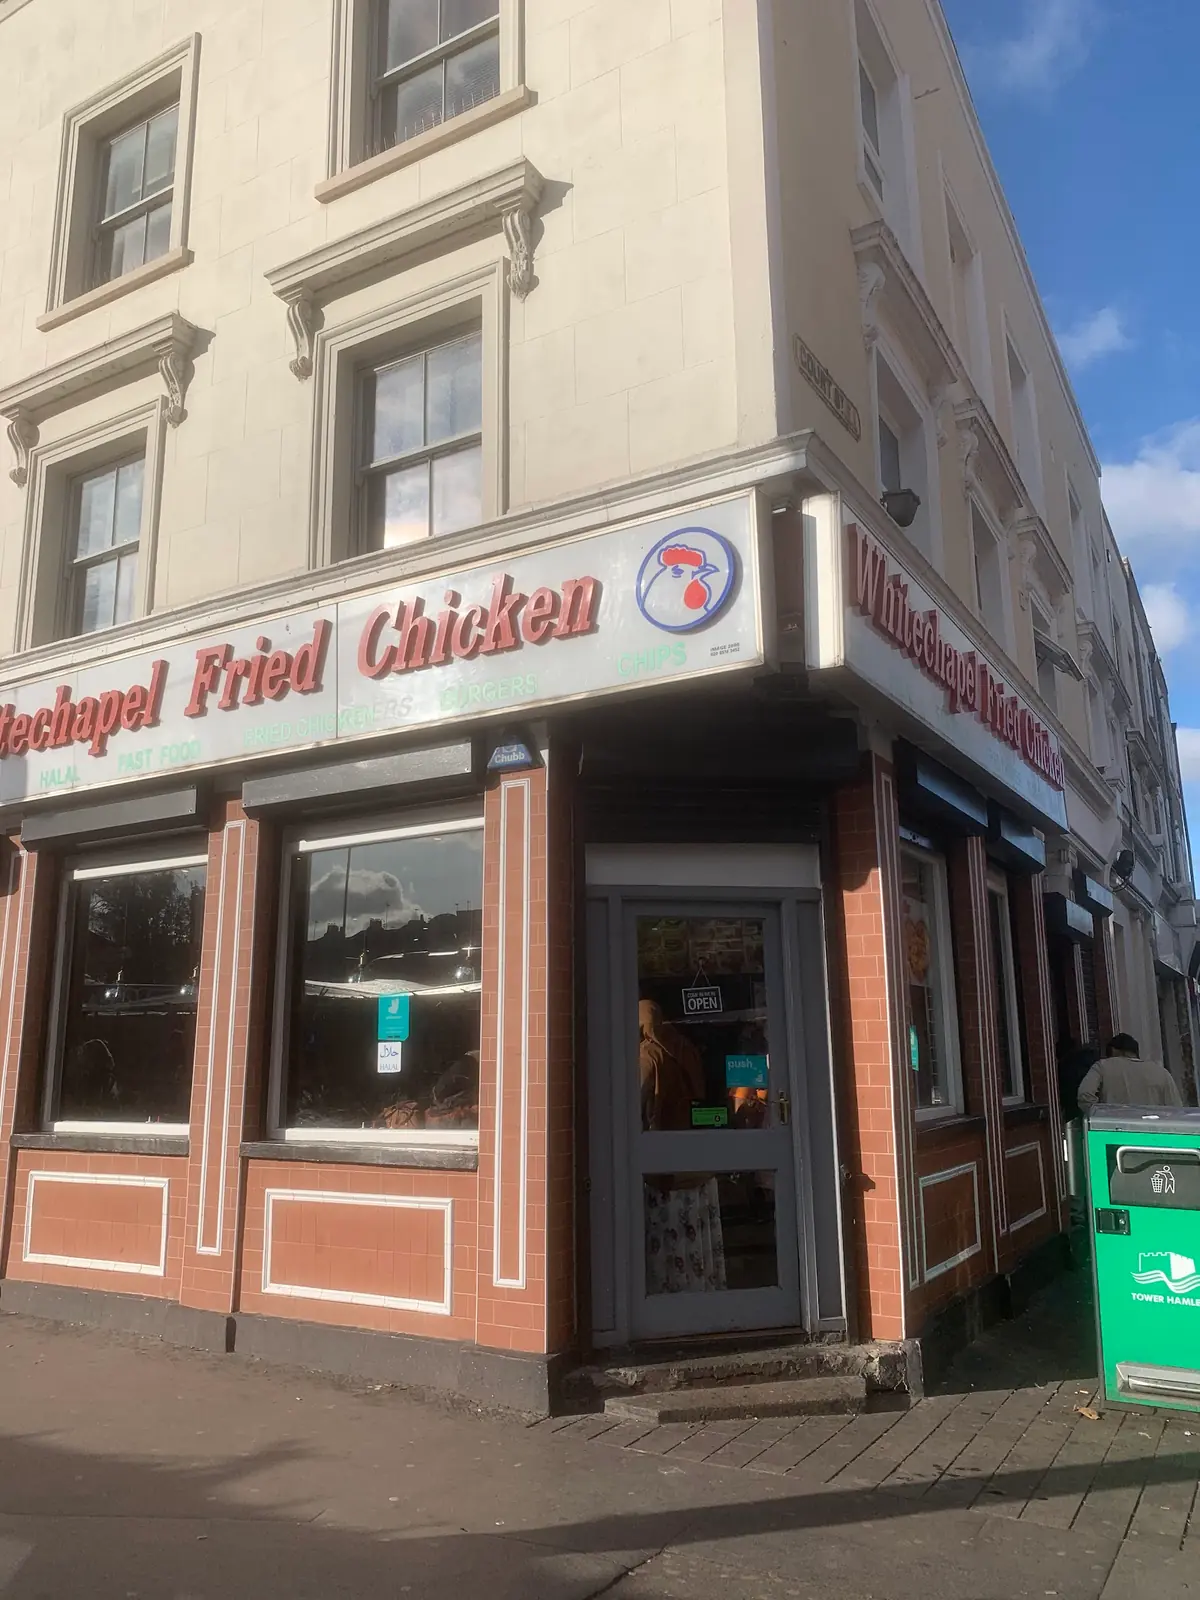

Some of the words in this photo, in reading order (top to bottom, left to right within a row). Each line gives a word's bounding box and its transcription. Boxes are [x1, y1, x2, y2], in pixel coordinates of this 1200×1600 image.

[184, 619, 333, 717] Fried
[357, 573, 602, 680] Chicken
[847, 523, 981, 714] Whitechapel
[980, 664, 1020, 750] Fried
[1019, 709, 1065, 791] Chicken
[40, 765, 81, 788] HALAL
[117, 749, 153, 773] FAST
[159, 739, 201, 766] FOOD
[244, 723, 292, 748] FRIED
[297, 706, 376, 738] CHICKEN
[439, 674, 538, 712] BURGERS
[617, 641, 687, 677] CHIPS
[494, 752, 526, 764] Chubb
[688, 997, 718, 1010] OPEN
[380, 1045, 399, 1058] حلال
[379, 1063, 399, 1071] HALAL
[727, 1058, 753, 1071] push
[1131, 1292, 1164, 1303] TOWER
